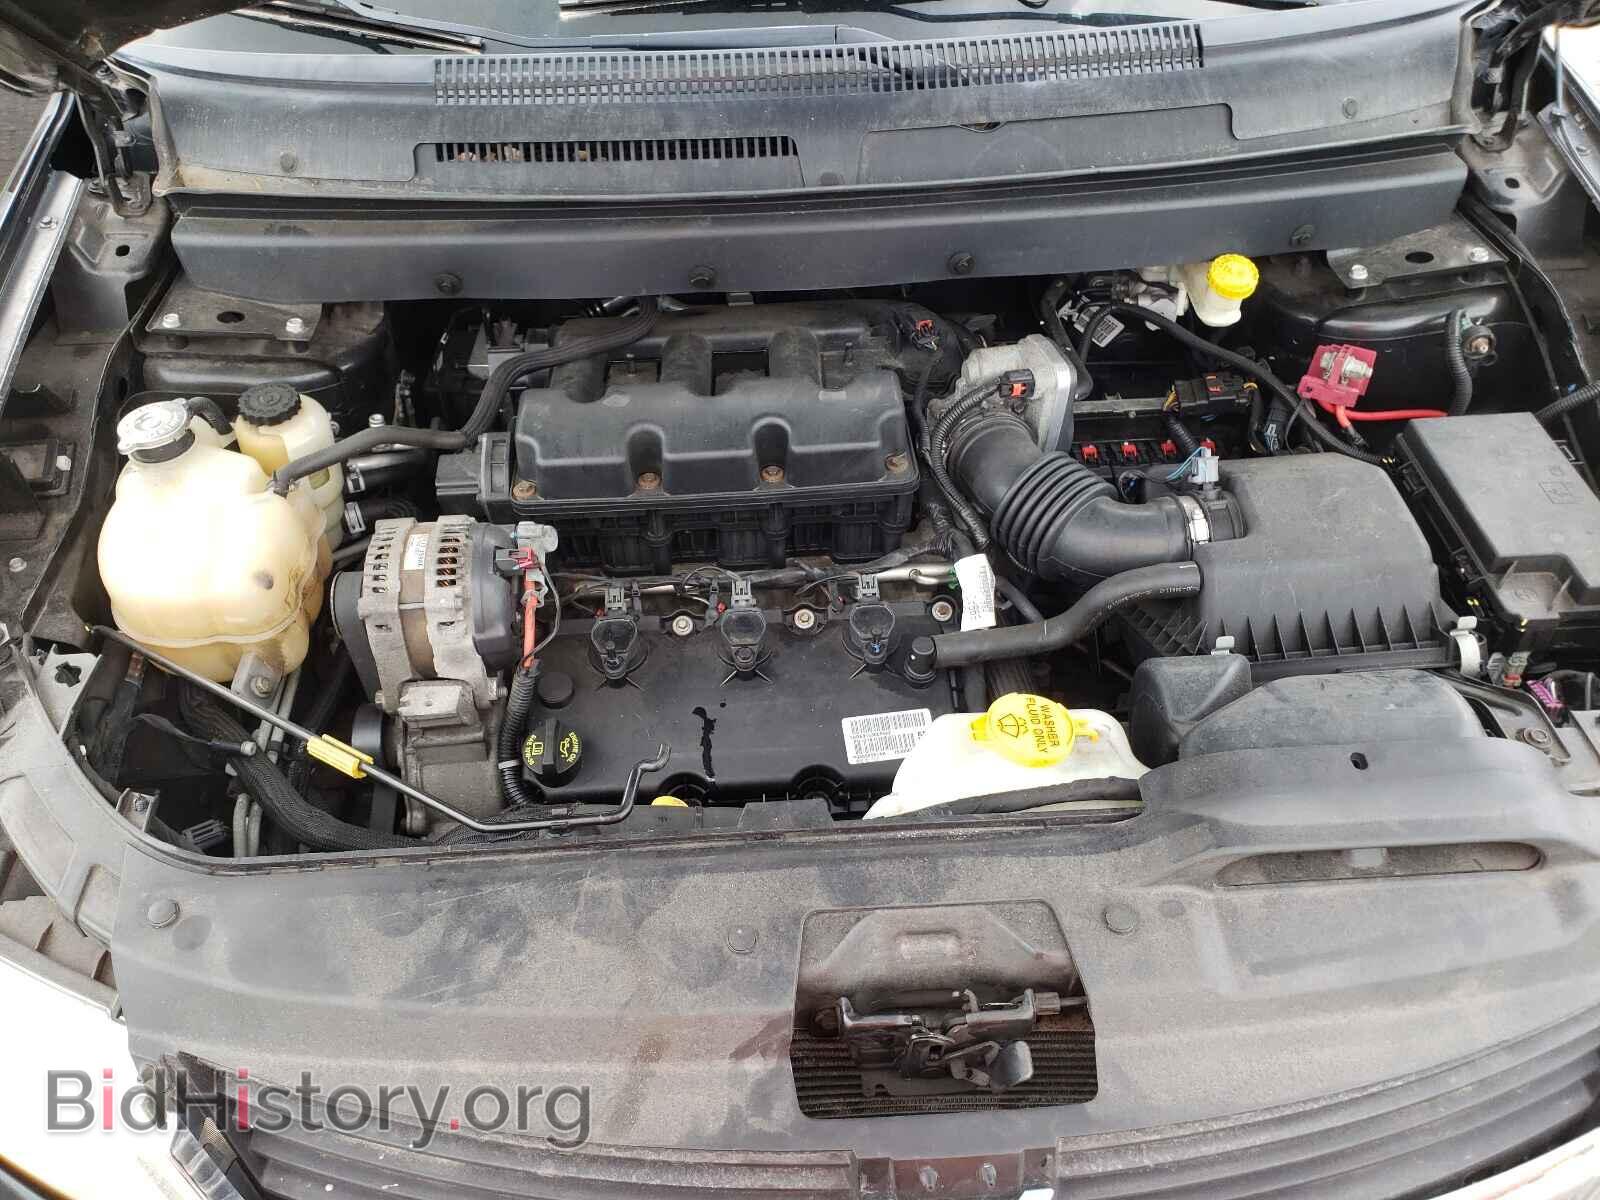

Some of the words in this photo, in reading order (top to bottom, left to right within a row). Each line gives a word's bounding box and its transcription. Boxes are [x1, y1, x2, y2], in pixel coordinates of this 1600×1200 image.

[1025, 697, 1041, 725] FLUID
[1040, 704, 1060, 747] WASHER
[1032, 728, 1048, 753] ONLY
